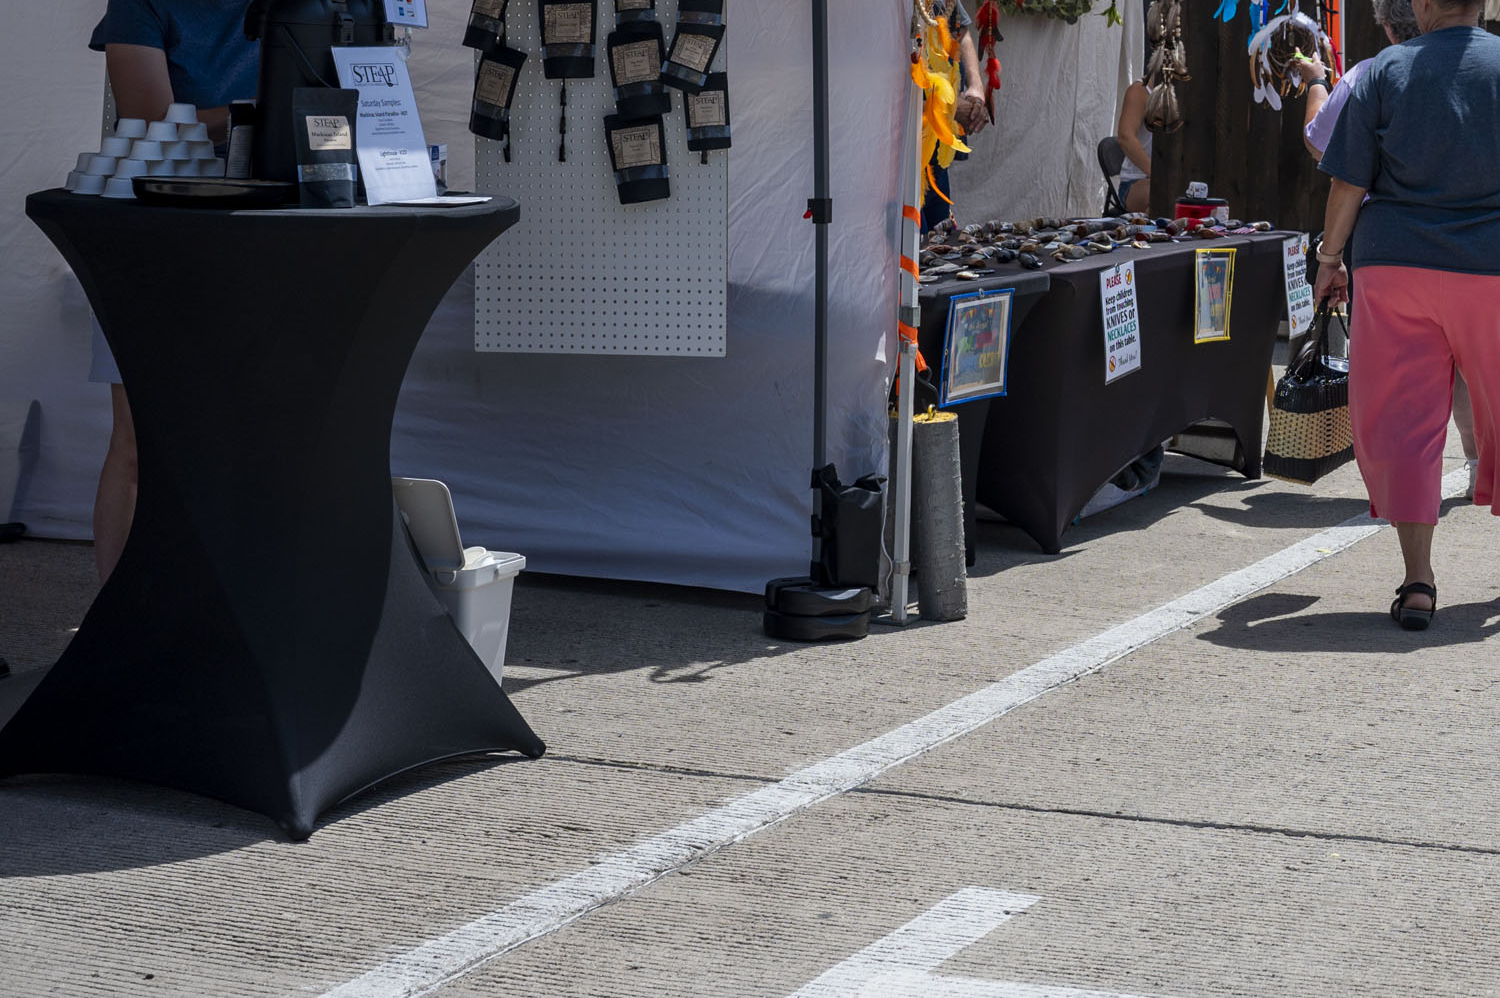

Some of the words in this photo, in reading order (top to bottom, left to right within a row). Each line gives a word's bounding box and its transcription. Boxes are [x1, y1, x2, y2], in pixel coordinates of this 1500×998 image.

[1106, 273, 1121, 290] PLEASE
[1105, 294, 1116, 306] Keep
[1116, 288, 1132, 301] children
[1289, 286, 1311, 302] NECKLACES
[1106, 304, 1116, 315] from
[1117, 297, 1134, 311] touching
[1106, 312, 1128, 330] KNIVES
[1128, 308, 1136, 320] or
[1107, 320, 1137, 342] NECKLACES
[1116, 339, 1124, 349] this
